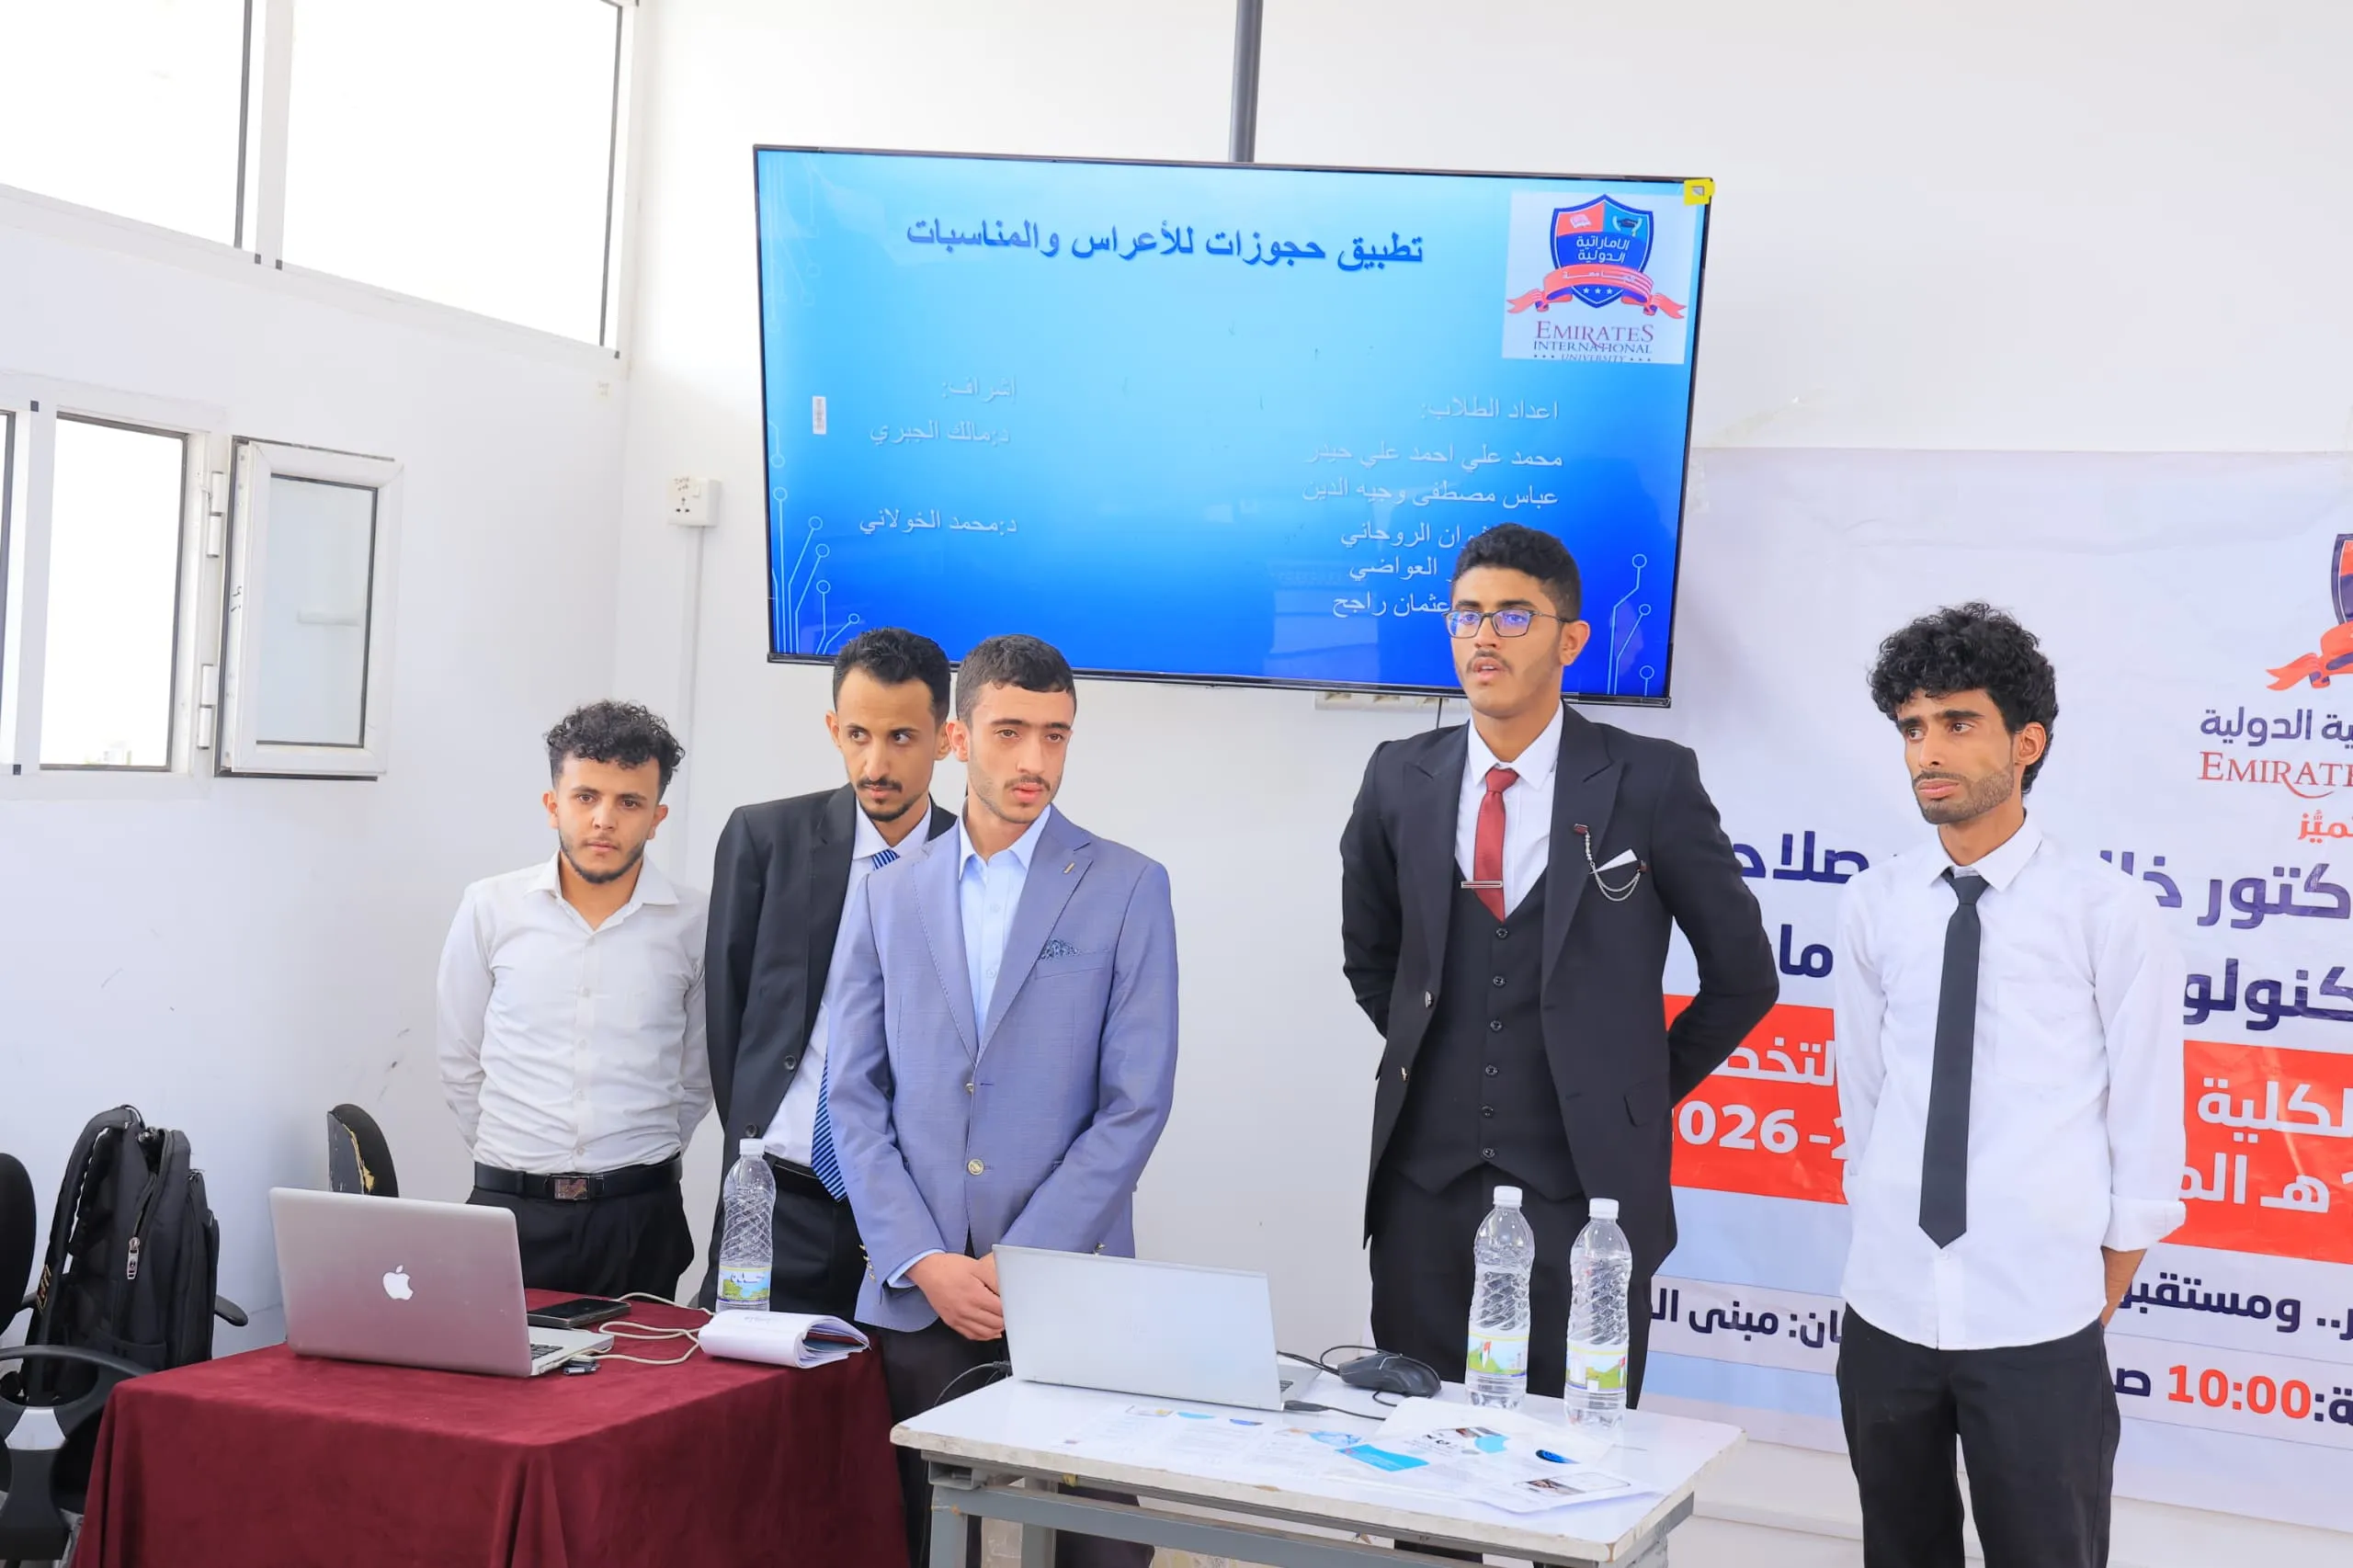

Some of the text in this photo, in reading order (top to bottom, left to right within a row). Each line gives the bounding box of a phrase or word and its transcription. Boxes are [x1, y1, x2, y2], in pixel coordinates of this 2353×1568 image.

[906, 217, 1424, 271] تطبيق حجوزات للأعراس والمناسبات
[1533, 339, 1653, 355] INTERNATIONAL
[1535, 320, 1654, 347] EMIRATES
[870, 419, 940, 446] الجبري
[1358, 440, 1400, 469] علي
[1461, 443, 1502, 473] علي
[1510, 448, 1563, 467] محمد
[1302, 476, 1349, 501] الدين
[1502, 484, 1560, 508] عباس
[859, 507, 941, 536] الخولاني
[1340, 520, 1431, 549] الروحاني
[1349, 555, 1438, 582] العواضي
[1333, 590, 1450, 619] عثمان راجح
[2200, 706, 2313, 747] الدولية
[2197, 1077, 2353, 1143] لكلية
[1688, 1301, 1779, 1342] مبنى
